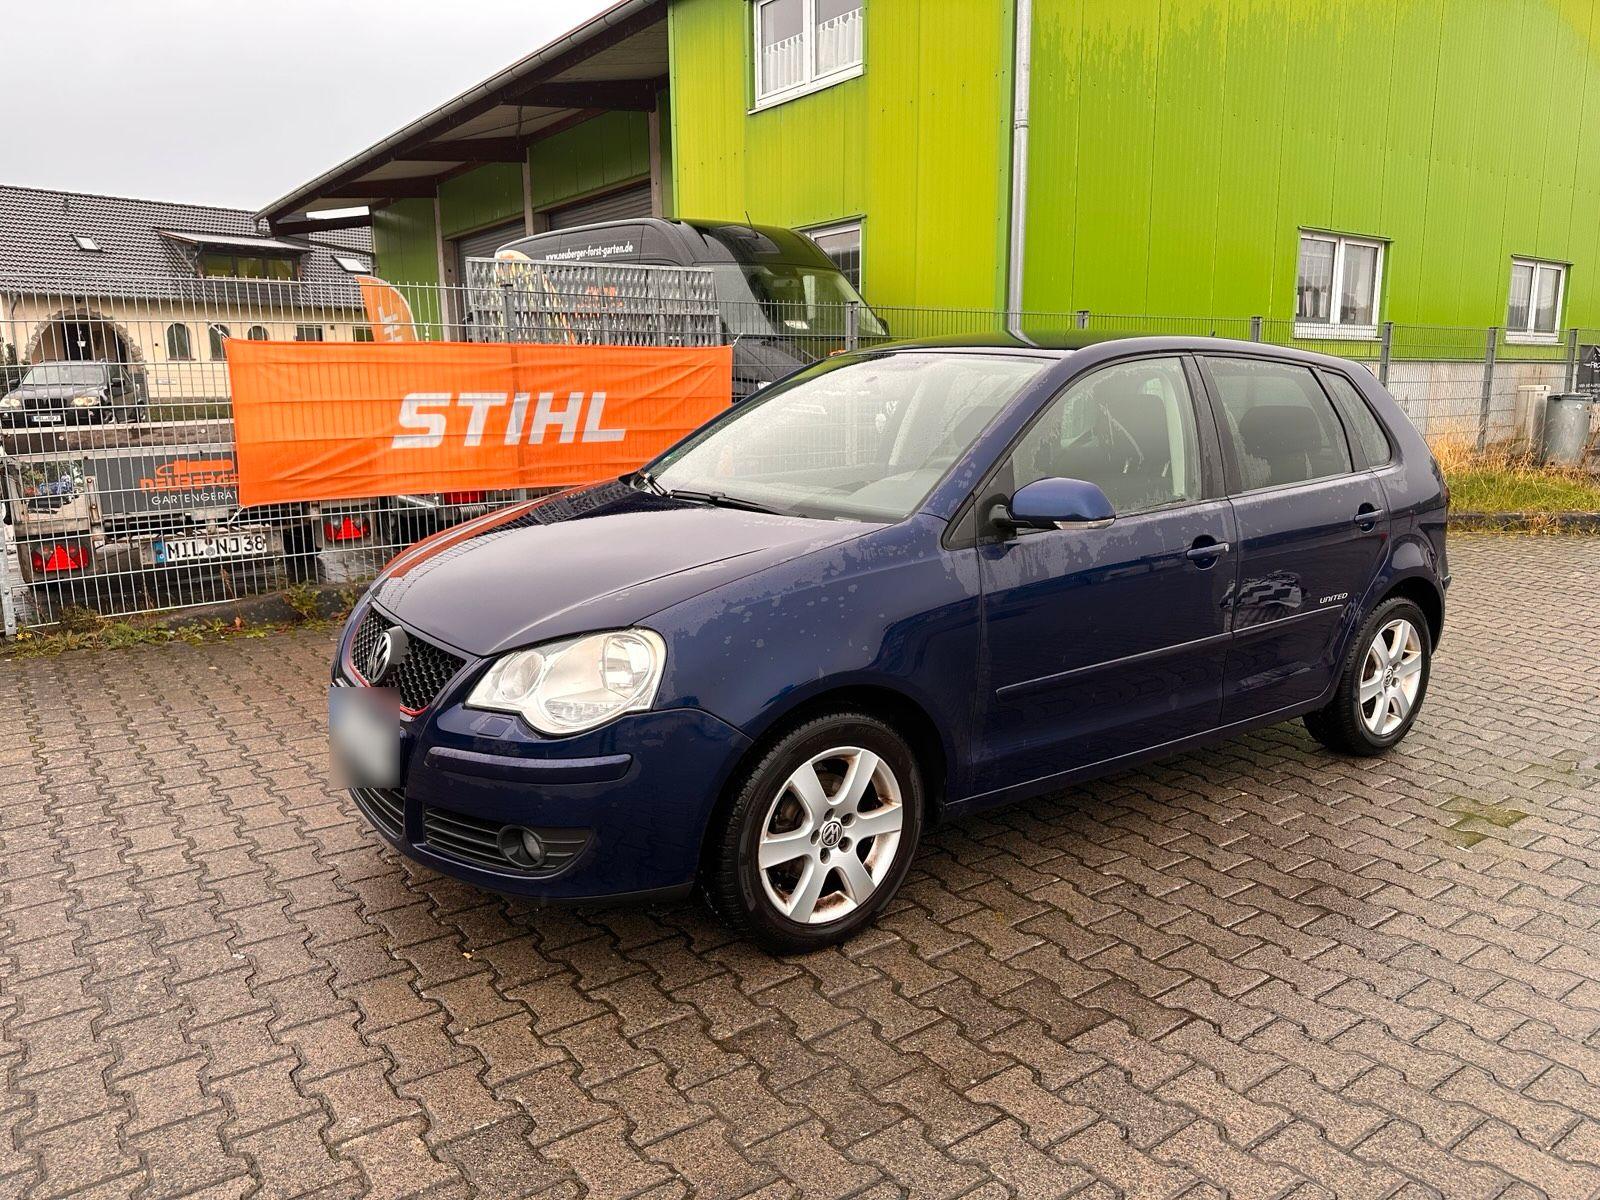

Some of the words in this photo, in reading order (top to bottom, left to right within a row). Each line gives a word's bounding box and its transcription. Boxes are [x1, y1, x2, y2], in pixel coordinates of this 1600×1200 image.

[391, 392, 626, 449] STIHL
[167, 541, 204, 559] MIL
[1320, 592, 1348, 604] UNITED
